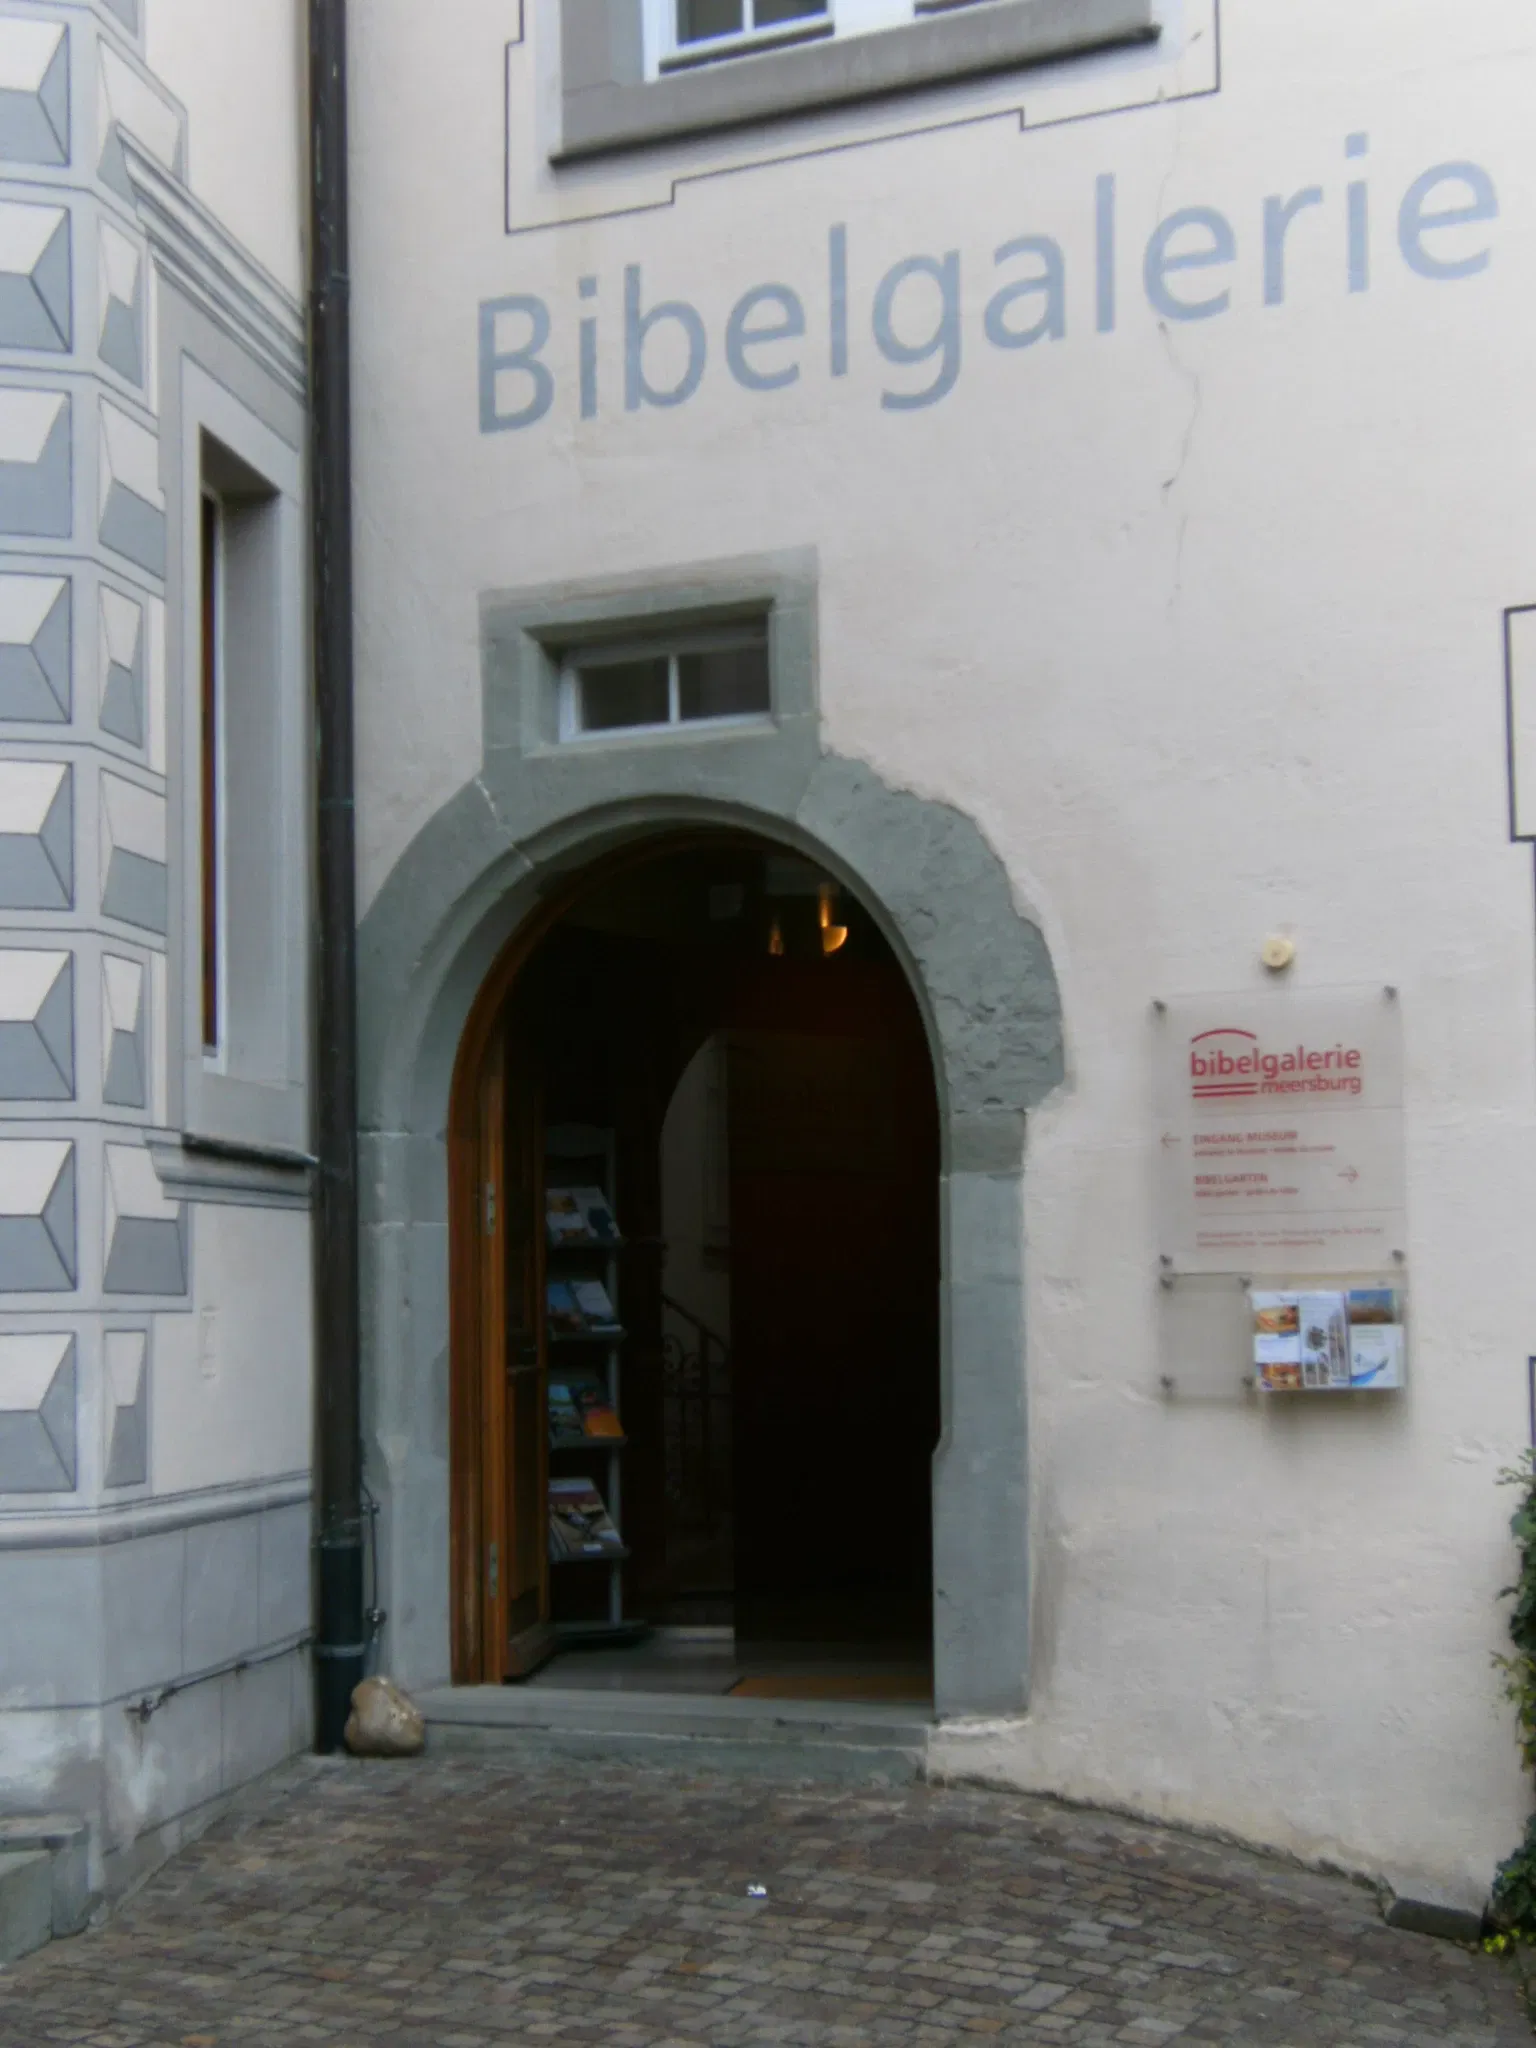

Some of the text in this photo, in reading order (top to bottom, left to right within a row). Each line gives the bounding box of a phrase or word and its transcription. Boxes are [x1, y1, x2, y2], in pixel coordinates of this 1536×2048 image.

[478, 132, 1500, 433] Bibelgalerie
[1190, 1043, 1361, 1079] bibelgalerie
[1260, 1073, 1362, 1095] meersburg
[1193, 1130, 1298, 1145] EINGANG MUSEUM
